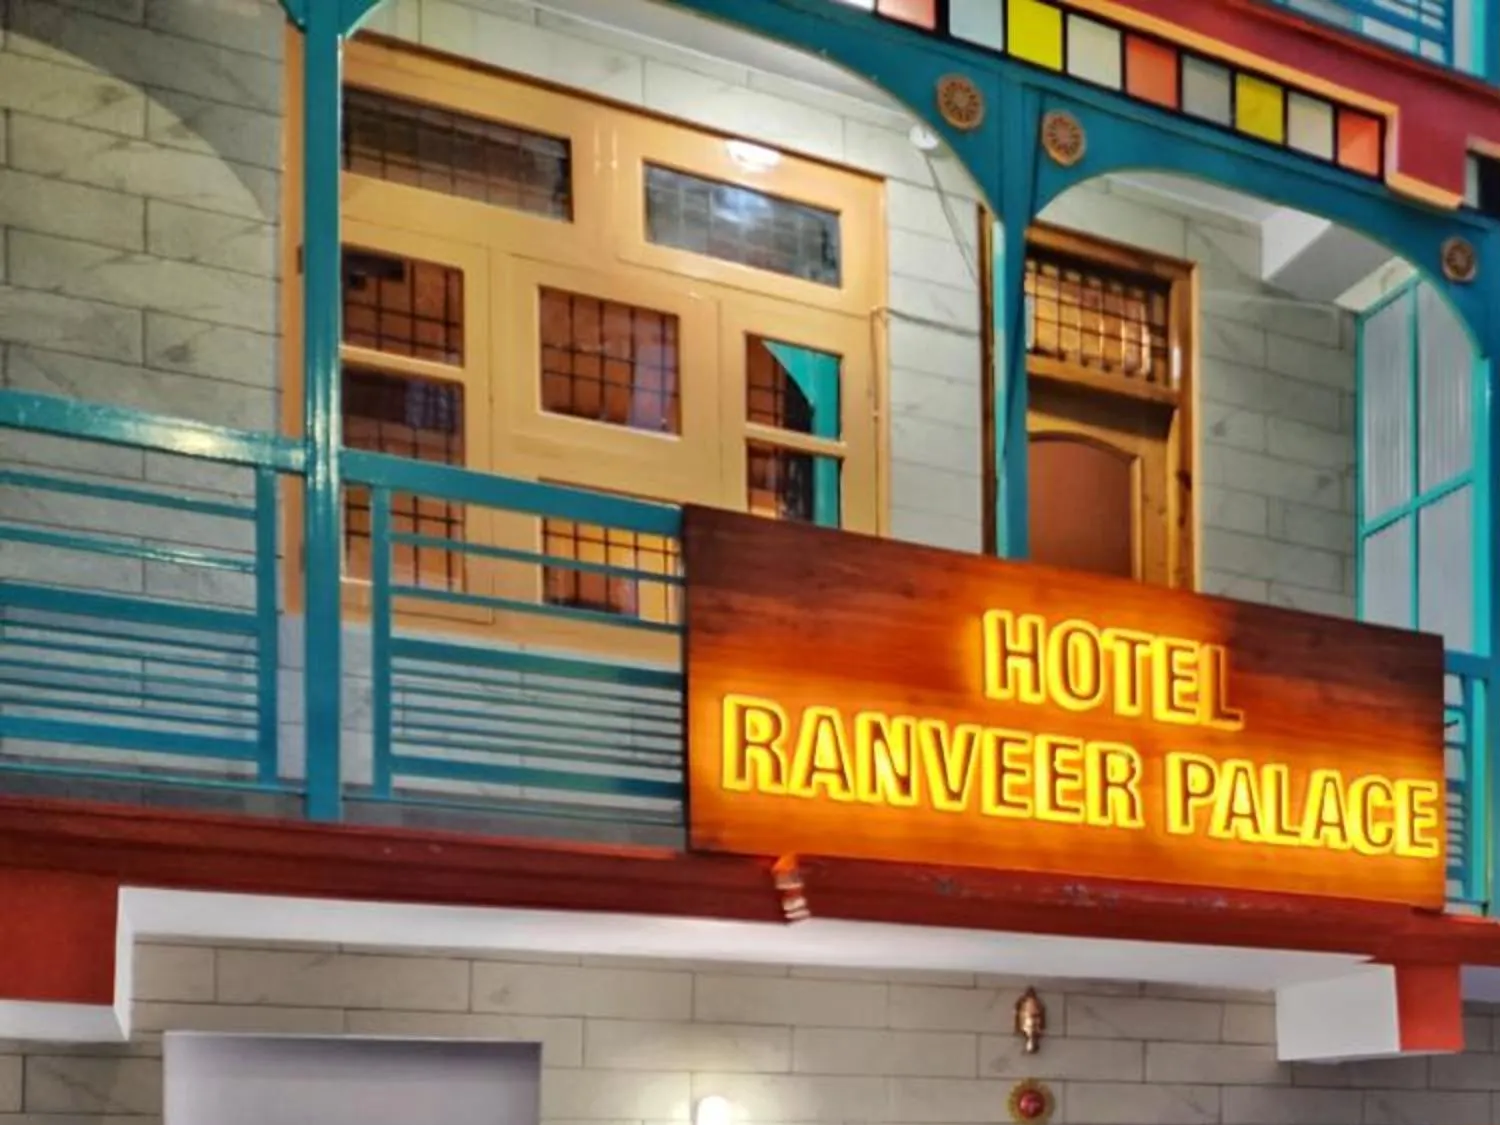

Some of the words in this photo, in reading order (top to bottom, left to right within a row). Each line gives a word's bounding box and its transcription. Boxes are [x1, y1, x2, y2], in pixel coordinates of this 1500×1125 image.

[982, 608, 1245, 730] HOTEL
[721, 693, 1145, 829] RANVEER
[1165, 751, 1441, 858] PALACE
